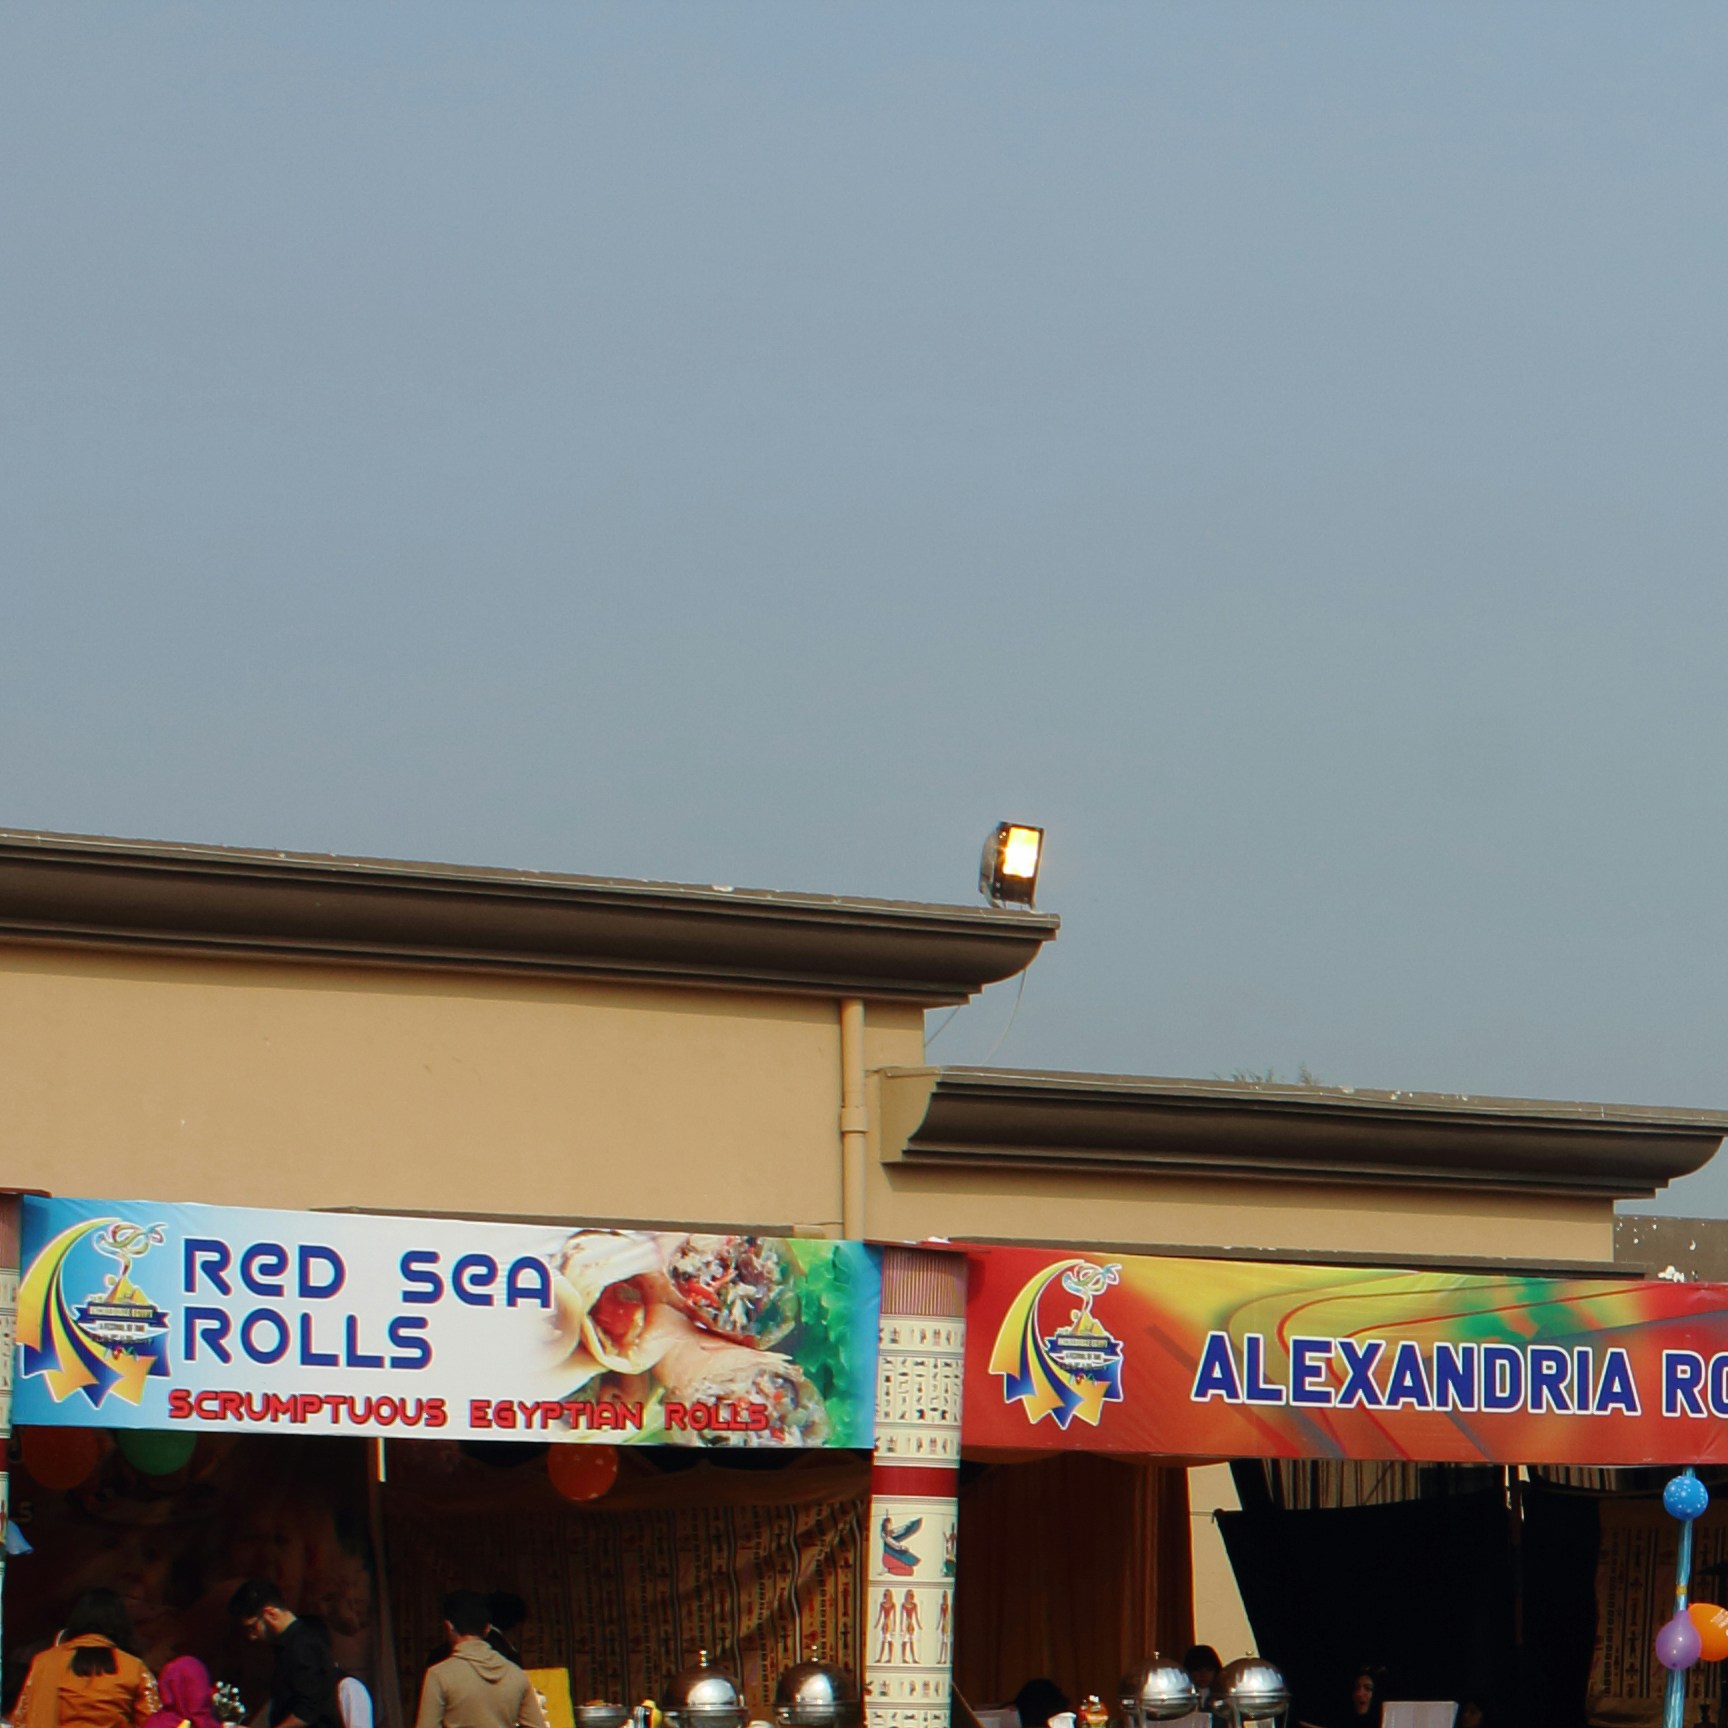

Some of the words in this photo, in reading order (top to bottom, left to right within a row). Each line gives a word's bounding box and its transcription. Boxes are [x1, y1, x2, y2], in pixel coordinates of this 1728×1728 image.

[181, 1306, 432, 1370] ROLLS
[1192, 1331, 1640, 1416] ALEXANDRIA
[168, 1389, 448, 1428] SCRUMPTUOUS
[468, 1399, 644, 1431] EGYPTIAN
[663, 1400, 770, 1432] ROLLS
